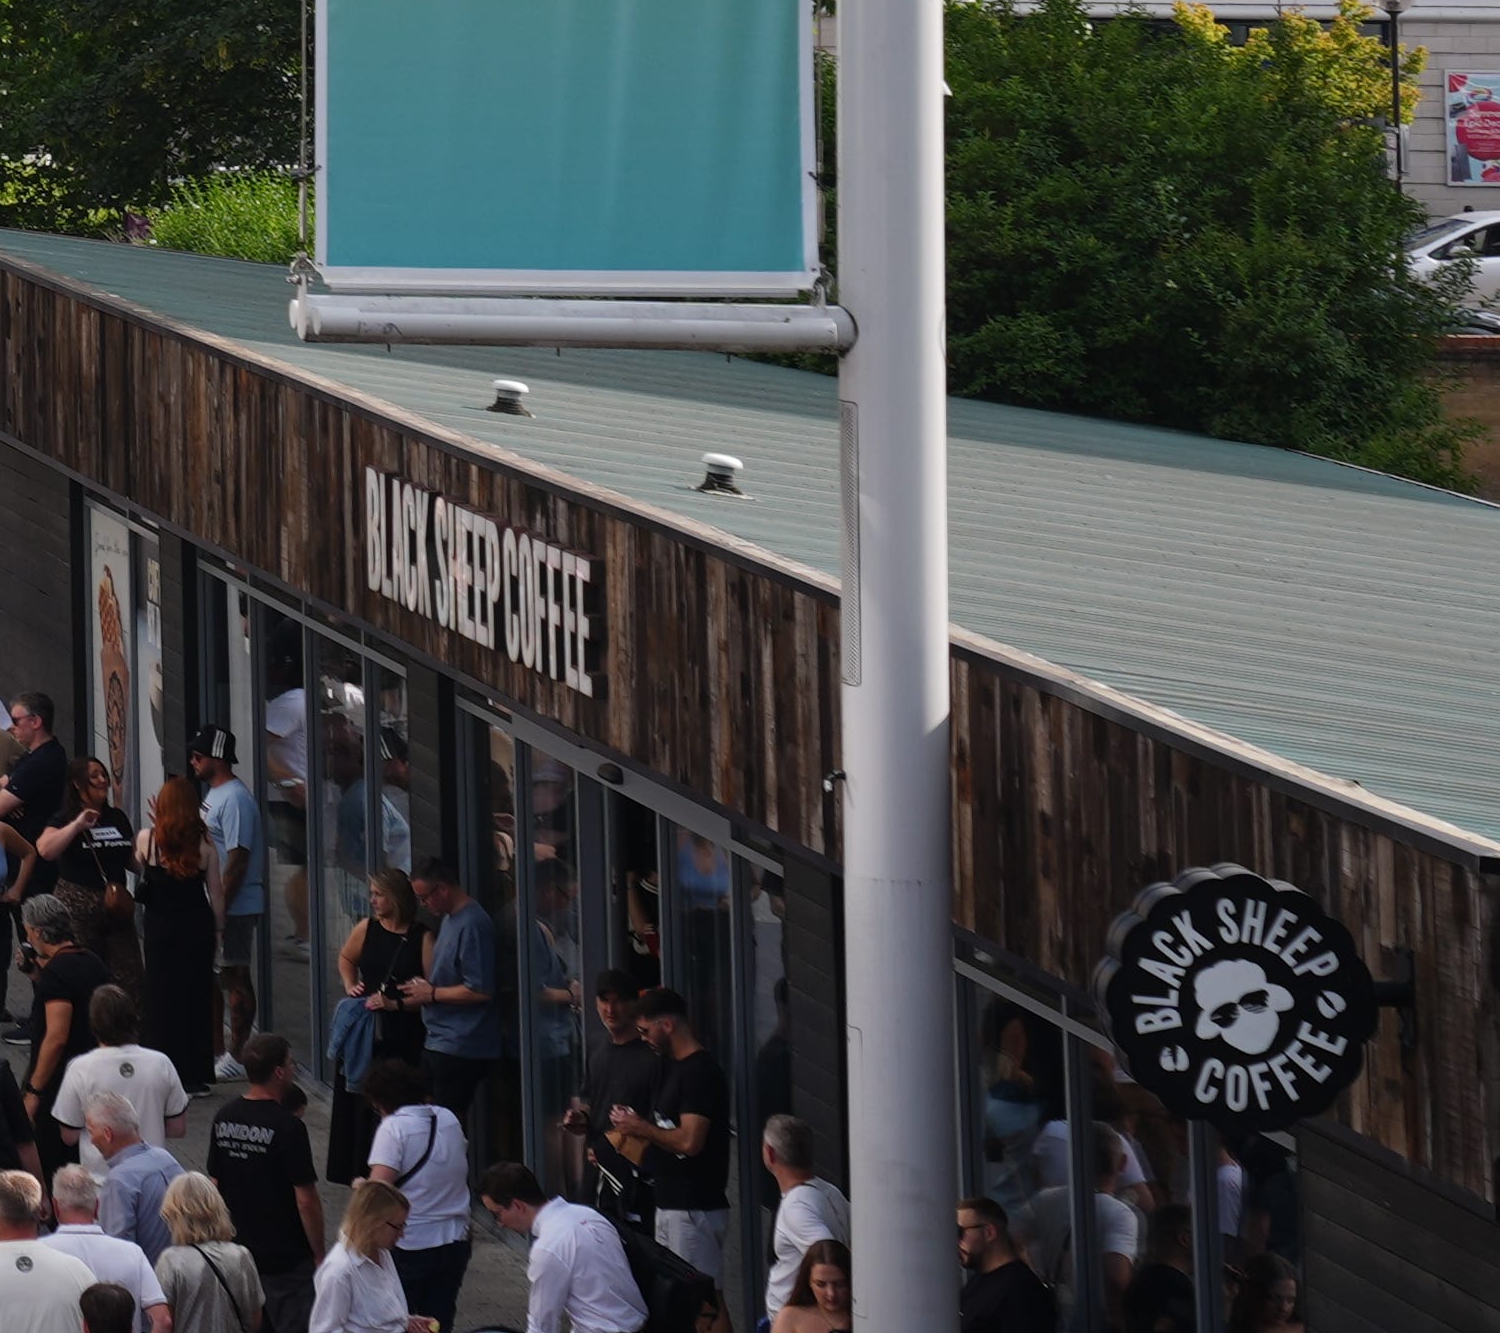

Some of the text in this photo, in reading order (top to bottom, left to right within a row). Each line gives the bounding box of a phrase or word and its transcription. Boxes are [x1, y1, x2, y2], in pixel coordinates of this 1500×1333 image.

[365, 466, 593, 698] BLACK SHEEP COFFEE
[1131, 897, 1340, 1035] BLACK SHEEP
[1194, 1020, 1349, 1113] COFFEE
